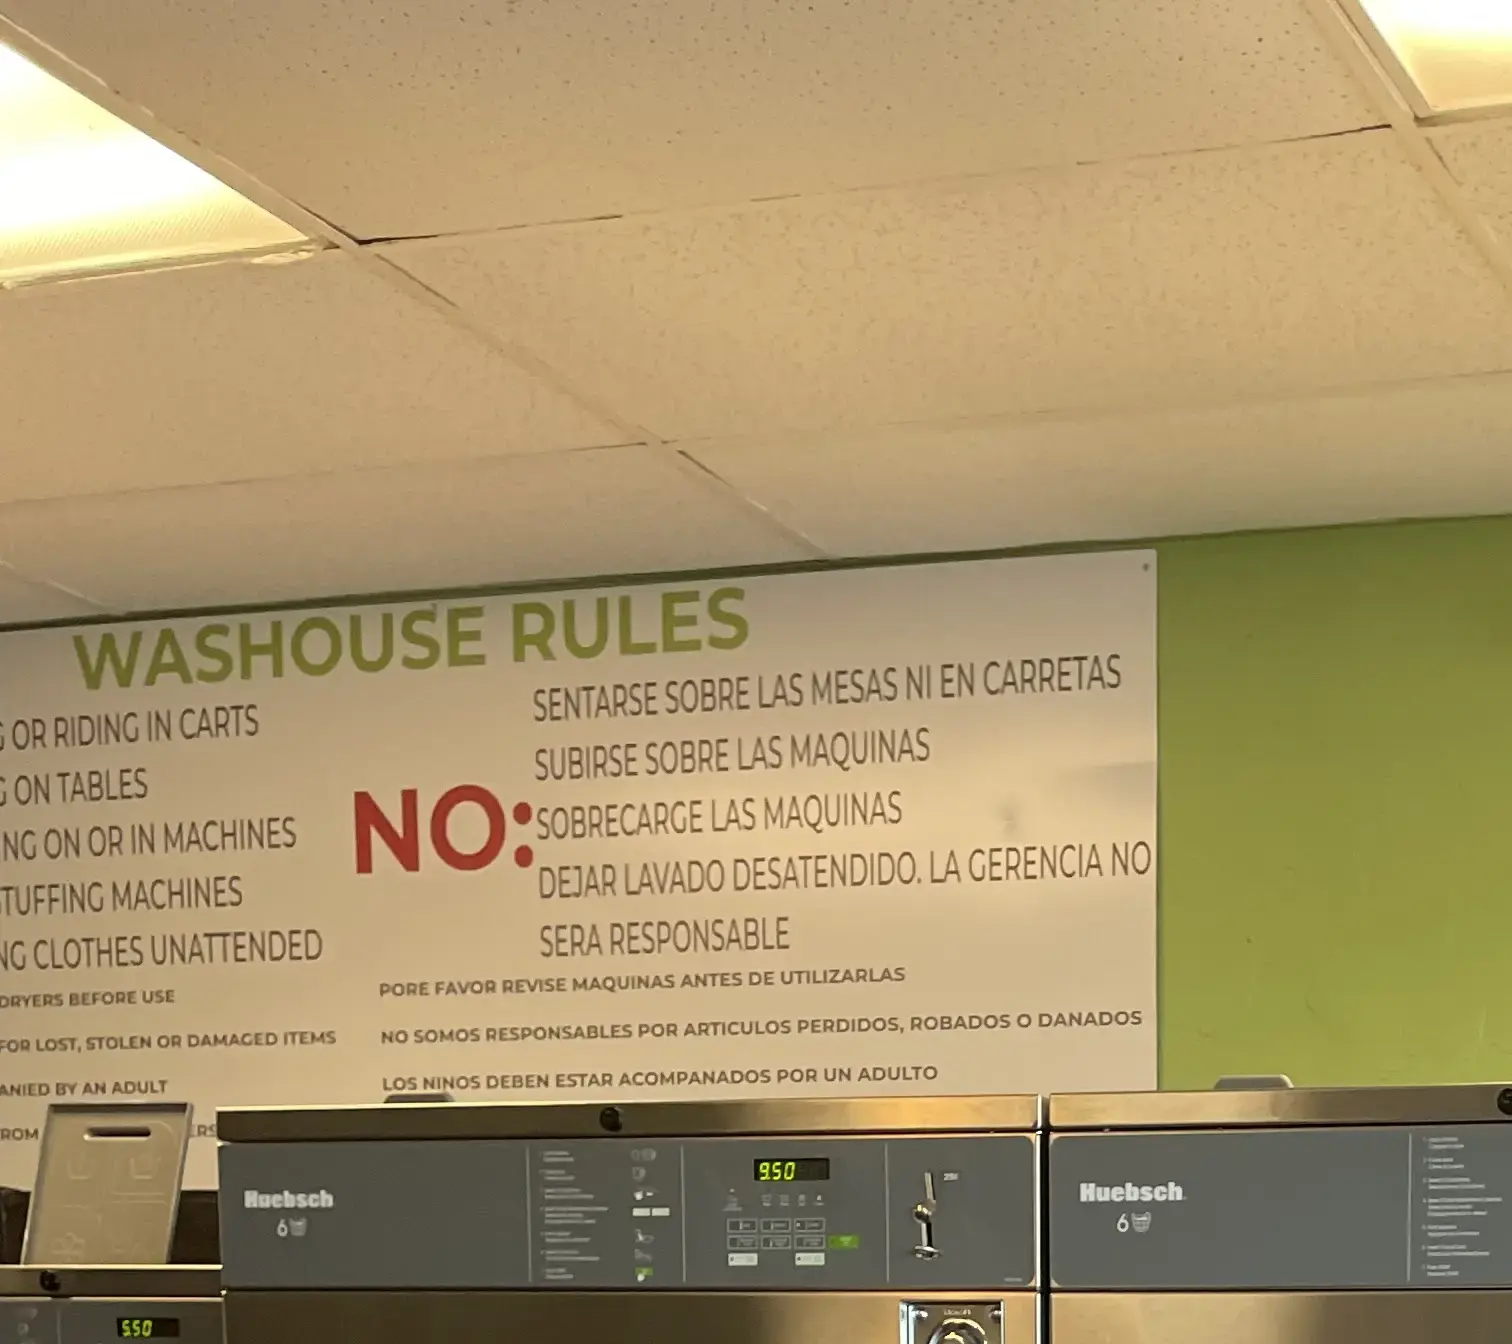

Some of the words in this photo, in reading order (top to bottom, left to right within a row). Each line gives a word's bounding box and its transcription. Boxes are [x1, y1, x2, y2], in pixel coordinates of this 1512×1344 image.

[74, 606, 486, 690] WASHOUSE
[513, 587, 748, 662] RULES
[534, 682, 658, 721] SENTARSE
[666, 676, 750, 714] SOBRE
[759, 673, 803, 708] LAS
[812, 667, 897, 705] MESAS
[907, 665, 931, 700] NI
[941, 663, 974, 698] EN
[984, 654, 1121, 695] CARRETAS
[12, 719, 46, 750] OR
[55, 712, 139, 747] RIDING
[148, 710, 171, 741] IN
[180, 704, 258, 739] CARTS
[536, 744, 638, 781] SUBIRSE
[646, 738, 728, 775] SOBRE
[738, 736, 782, 770] LAS
[791, 727, 929, 771] MAQUINAS
[14, 774, 50, 805] ON
[57, 768, 147, 802] TABLES
[354, 784, 535, 875] NO:
[537, 800, 703, 840] SOBRECARGE
[712, 798, 755, 832] LAS
[764, 791, 902, 833] MAQUINAS
[44, 828, 80, 859] ON
[88, 826, 123, 856] OR
[131, 823, 155, 854] IN
[164, 817, 296, 853] MACHINES
[540, 864, 616, 898] DEJAR
[625, 860, 724, 895] LAVADO
[734, 852, 921, 891] DESATENDIDO.
[931, 850, 961, 883] LA
[969, 844, 1103, 881] GERENCIA
[1112, 841, 1150, 876] NO
[0, 882, 103, 916] TUFFING
[112, 876, 242, 911] MACHINES
[34, 936, 143, 969] CLOTHES
[151, 929, 322, 965] UNATTENDED
[541, 924, 602, 957] SERA
[610, 917, 790, 955] RESPONSABLE
[69, 991, 136, 1006] BEFORE
[142, 990, 174, 1004] USE
[380, 982, 429, 997] PORE
[435, 980, 496, 995] FAVOR
[503, 978, 566, 993] REVISE
[573, 975, 675, 993] MAQUINAS
[680, 972, 742, 988] ANTES
[749, 972, 774, 985] DE
[781, 967, 905, 985] UTILIZARLAS
[36, 1038, 81, 1053] LOST,
[86, 1036, 151, 1050] STOLEN
[157, 1035, 181, 1048] OR
[187, 1032, 278, 1047] DAMAGED
[284, 1031, 336, 1045] ITEMS
[382, 1030, 408, 1044] NO
[414, 1028, 480, 1043] SOMOS
[486, 1024, 632, 1041] RESPONSABLES
[639, 1023, 677, 1037] POR
[684, 1020, 791, 1036] ARTICULOS
[798, 1017, 904, 1033] PERDIDOS,
[911, 1014, 1011, 1030] ROBADOS
[1017, 1014, 1032, 1028] O
[1039, 1011, 1142, 1027] DANADOS
[56, 1083, 77, 1096] BY
[83, 1083, 106, 1094] AN
[112, 1080, 167, 1094] ADULT
[383, 1077, 417, 1091] LOS
[423, 1075, 480, 1090] NINOS
[487, 1074, 549, 1089] DEBEN
[556, 1073, 612, 1087] ESTAR
[619, 1070, 771, 1086] ACOMPANADOS
[777, 1069, 817, 1083] POR
[824, 1068, 851, 1082] UN
[858, 1066, 938, 1081] ADULTO
[244, 1189, 334, 1209] Huebsch
[1080, 1182, 1184, 1202] Huebsch
[277, 1218, 289, 1237] 6
[1116, 1213, 1130, 1233] 6
